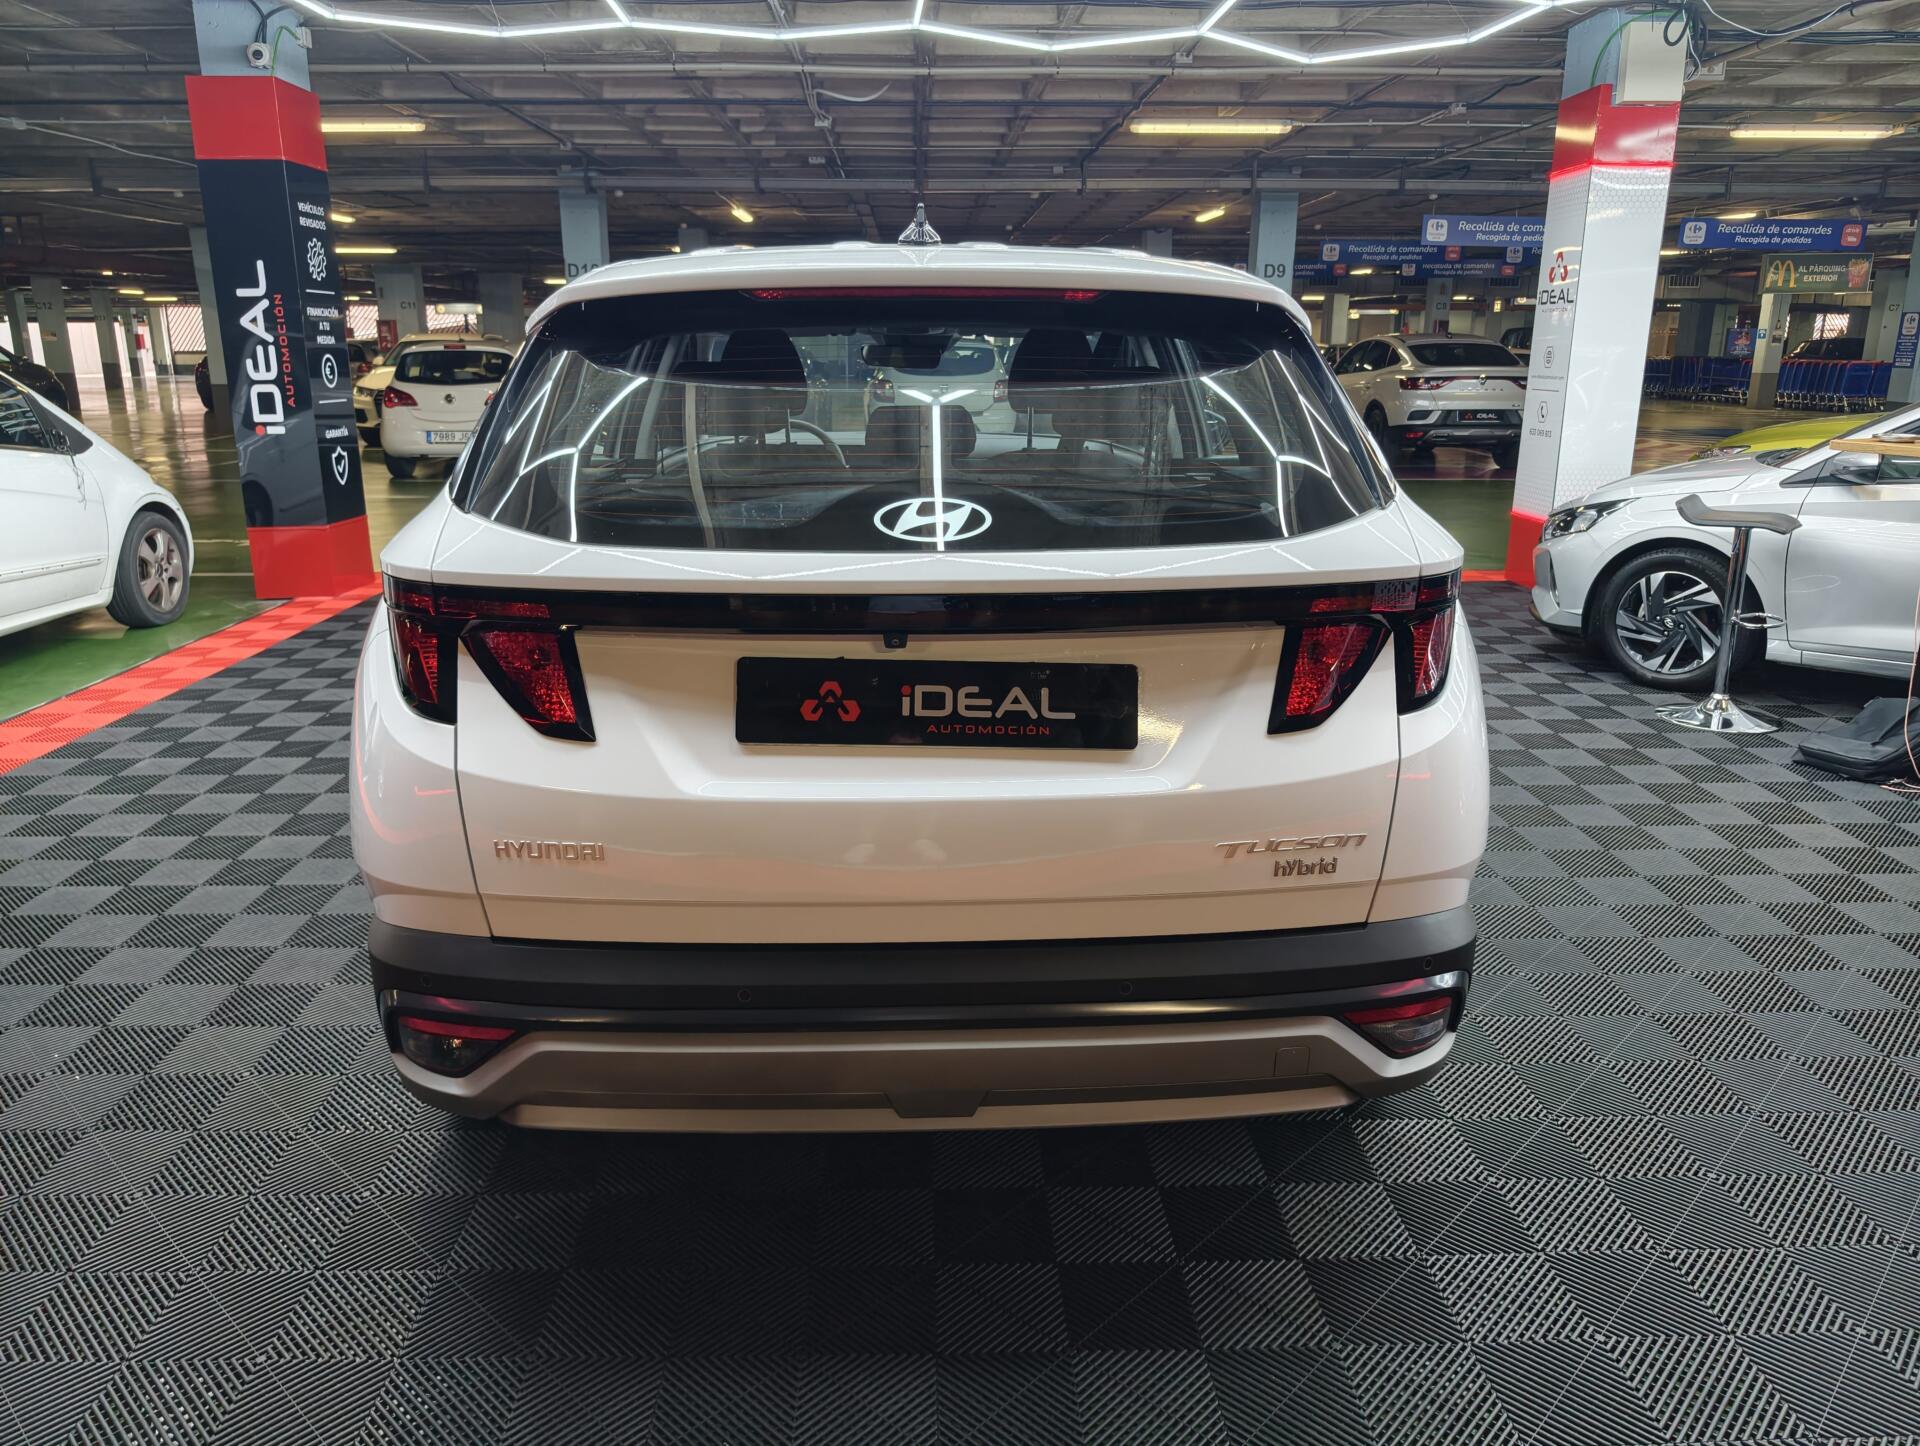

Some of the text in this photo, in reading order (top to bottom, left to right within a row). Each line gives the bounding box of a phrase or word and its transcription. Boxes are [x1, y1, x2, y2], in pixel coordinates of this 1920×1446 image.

[298, 202, 324, 216] VEHÍCULOS
[299, 216, 326, 230] REVISADOS
[1459, 221, 1504, 231] Recollida
[1507, 222, 1520, 231] de
[1718, 223, 1832, 235] Recollida de comandes
[1476, 233, 1510, 242] Recogida
[1512, 233, 1522, 241] de
[1735, 236, 1769, 244] Recogida
[1782, 236, 1812, 245] pedidos
[1348, 245, 1385, 253] Recollida
[1399, 245, 1438, 253] comandes
[1264, 264, 1286, 278] D9
[1798, 265, 1808, 273] AL
[1803, 274, 1839, 282] EXTERIOR
[1538, 288, 1574, 305] iDEAL
[306, 306, 339, 317] FINANCIACIÓN
[316, 335, 336, 344] MEDIDA
[236, 259, 286, 437] iDEAL
[273, 294, 296, 408] AUTOMOCIÓN
[325, 426, 348, 439] GARANTÍA
[433, 432, 455, 441] 7989
[901, 684, 1076, 719] iDEAL
[927, 724, 1050, 736] AUTOMOCIÓN
[493, 839, 605, 861] HYUNDAI
[1215, 832, 1368, 859] TUCSON
